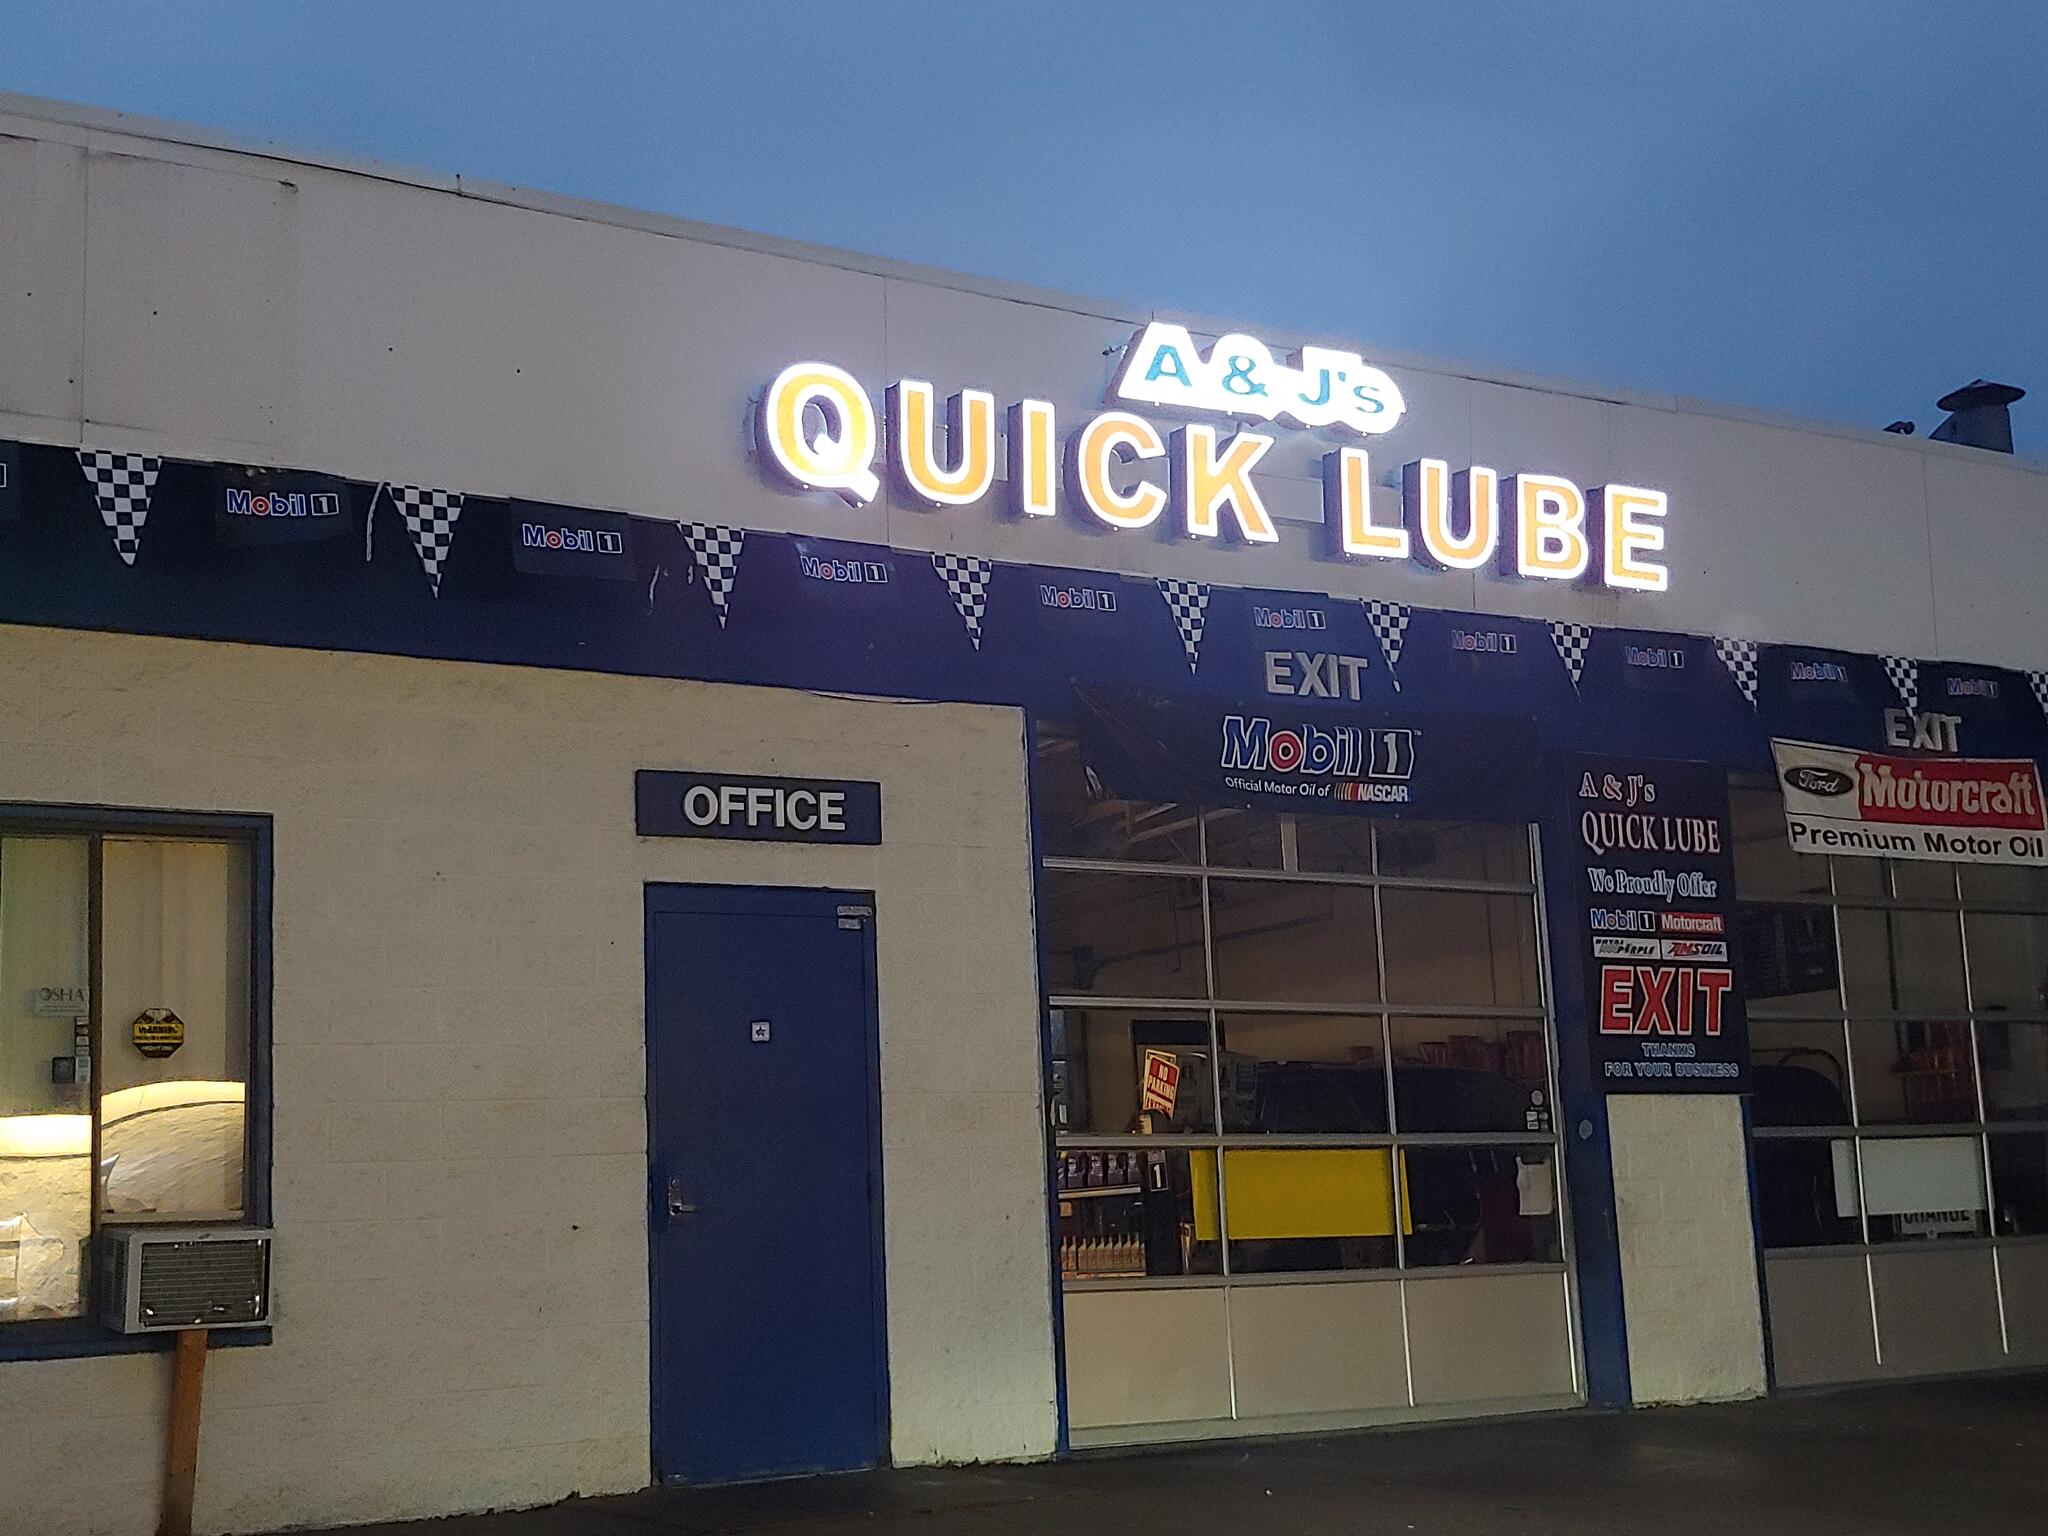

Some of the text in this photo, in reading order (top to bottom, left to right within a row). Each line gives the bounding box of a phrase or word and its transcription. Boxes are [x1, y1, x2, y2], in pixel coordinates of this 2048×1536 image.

[1298, 367, 1385, 414] J's
[763, 362, 1668, 592] QUICK LUBE
[226, 488, 306, 517] Mobil
[522, 523, 594, 554] Mobil
[801, 555, 863, 583] Mobil
[1040, 583, 1095, 610] Mobil
[1253, 607, 1306, 630] Mobil
[1451, 630, 1498, 652] Mobil
[1624, 646, 1668, 668] Mobil
[1790, 662, 1835, 682] Mobil
[1263, 651, 1368, 701] EXIT
[1221, 715, 1363, 776] Mobil
[1883, 708, 1962, 753] EXIT
[1224, 776, 1409, 802] Official Motor Oil of NASCAR
[1578, 771, 1656, 807] A & J's
[1798, 768, 1840, 794] Ford
[1858, 762, 2036, 816] Motorcraft
[684, 785, 846, 831] OFFICE
[1581, 811, 1721, 856] QUICK LUBE
[1789, 821, 2044, 859] Premium Motor Oil
[1587, 867, 1718, 903] We Proudly Offer
[1590, 908, 1638, 931] Mobil
[1661, 913, 1723, 932] Motorcraft
[1600, 964, 1733, 1036] EXIT
[1641, 1042, 1696, 1058] THANKS
[1604, 1061, 1740, 1078] FOR YOUR BUSINESS
